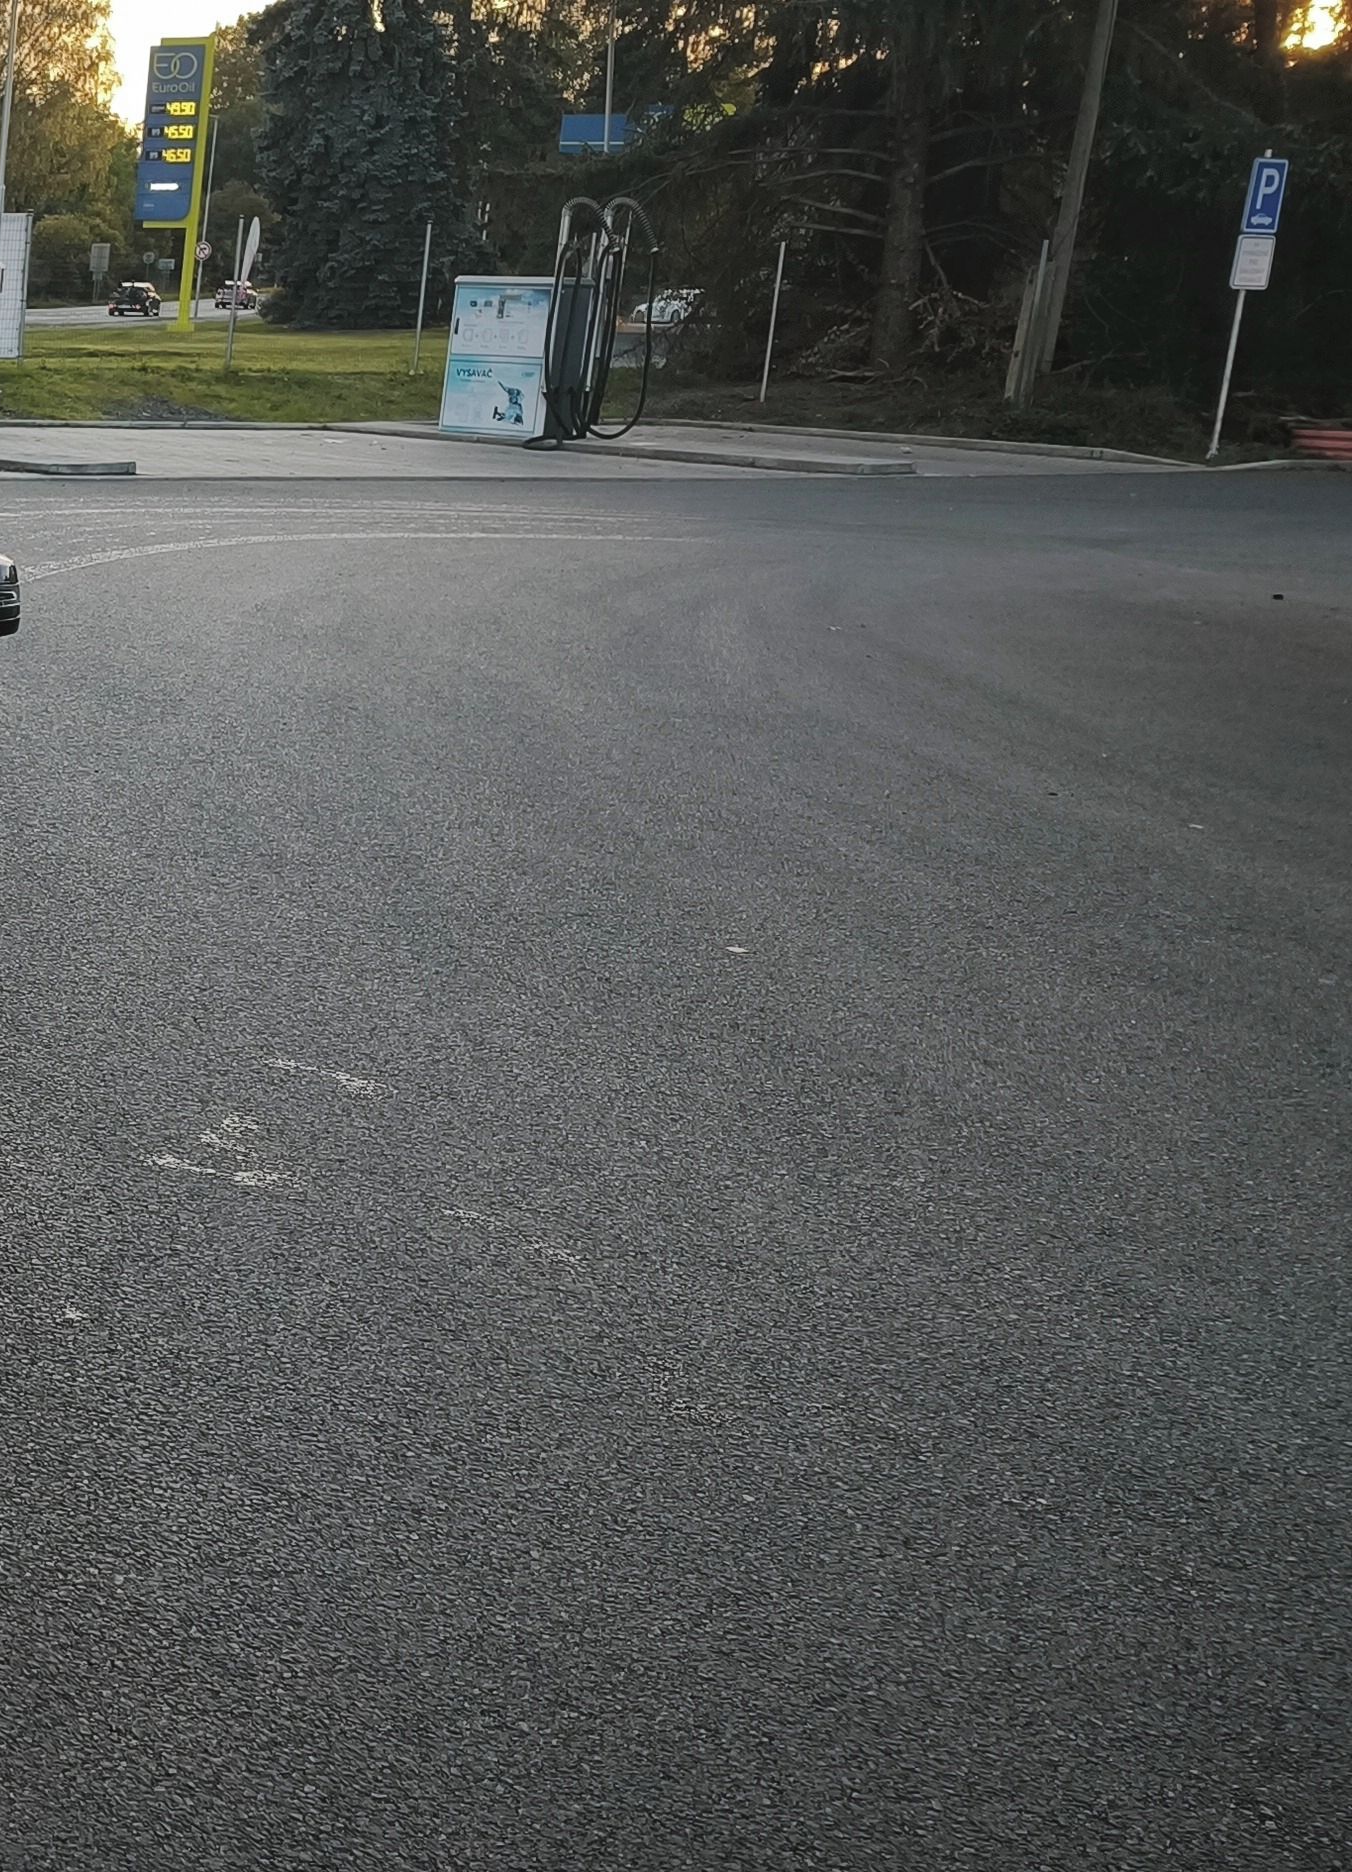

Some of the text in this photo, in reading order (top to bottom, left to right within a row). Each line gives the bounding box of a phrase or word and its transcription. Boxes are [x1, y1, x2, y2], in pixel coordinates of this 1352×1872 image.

[152, 81, 195, 93] EuroOil
[1256, 168, 1280, 209] P
[456, 367, 494, 378] VYSAVAČ
